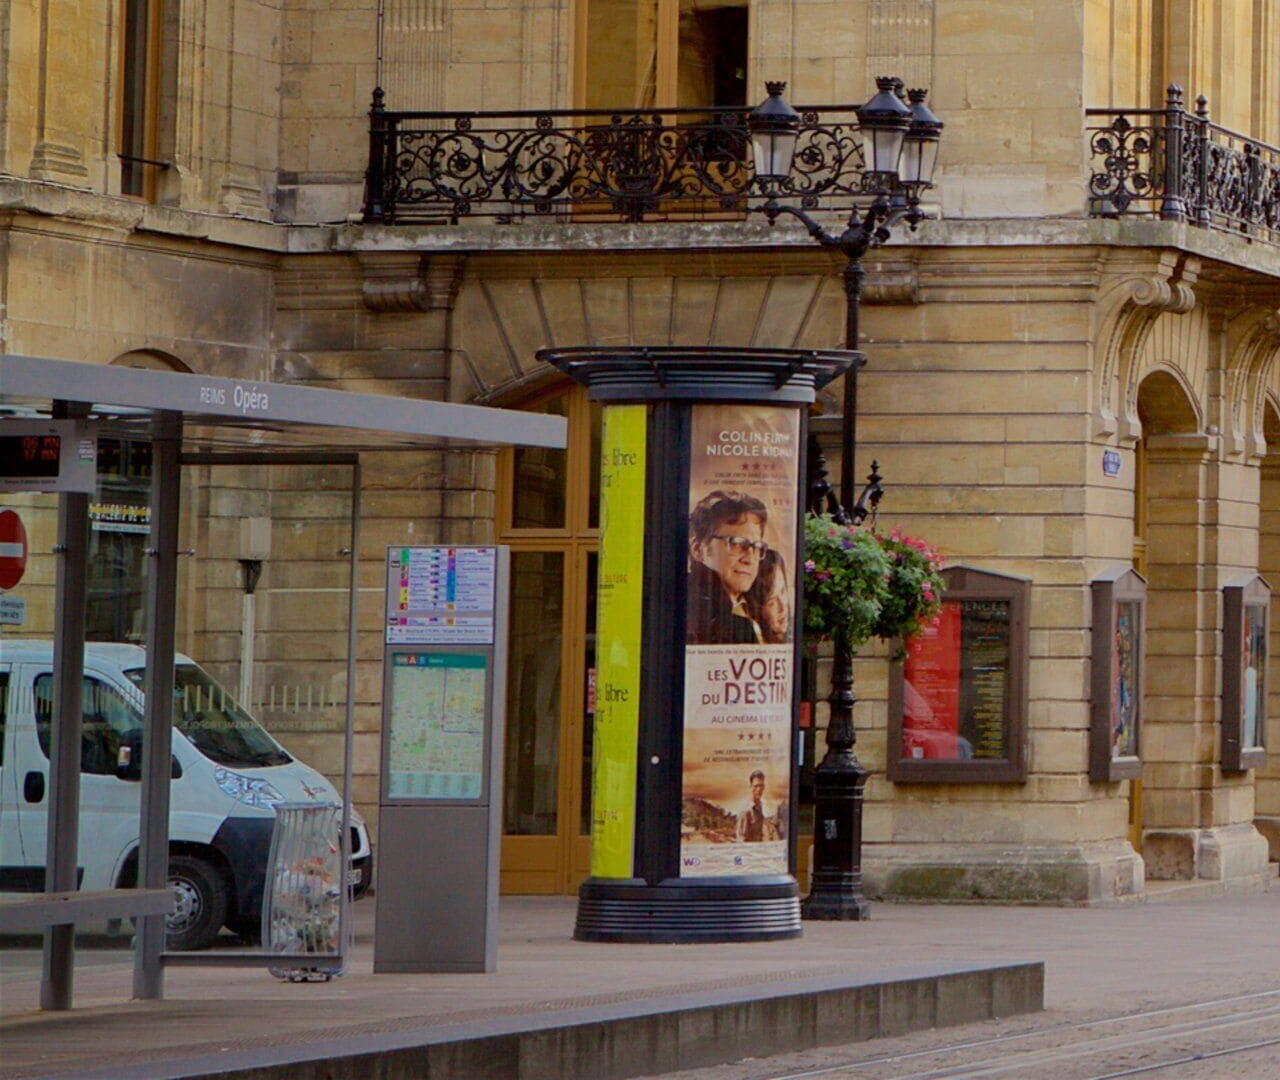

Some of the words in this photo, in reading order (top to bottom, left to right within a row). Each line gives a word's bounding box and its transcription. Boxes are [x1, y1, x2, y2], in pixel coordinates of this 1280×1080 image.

[200, 387, 226, 405] REIMS
[234, 385, 269, 414] Opéra
[719, 430, 761, 443] COLIN
[706, 444, 760, 457] NICOLE
[707, 669, 728, 681] LES
[728, 658, 786, 680] VOIES
[701, 693, 720, 705] DU
[724, 682, 787, 705] DESTIN
